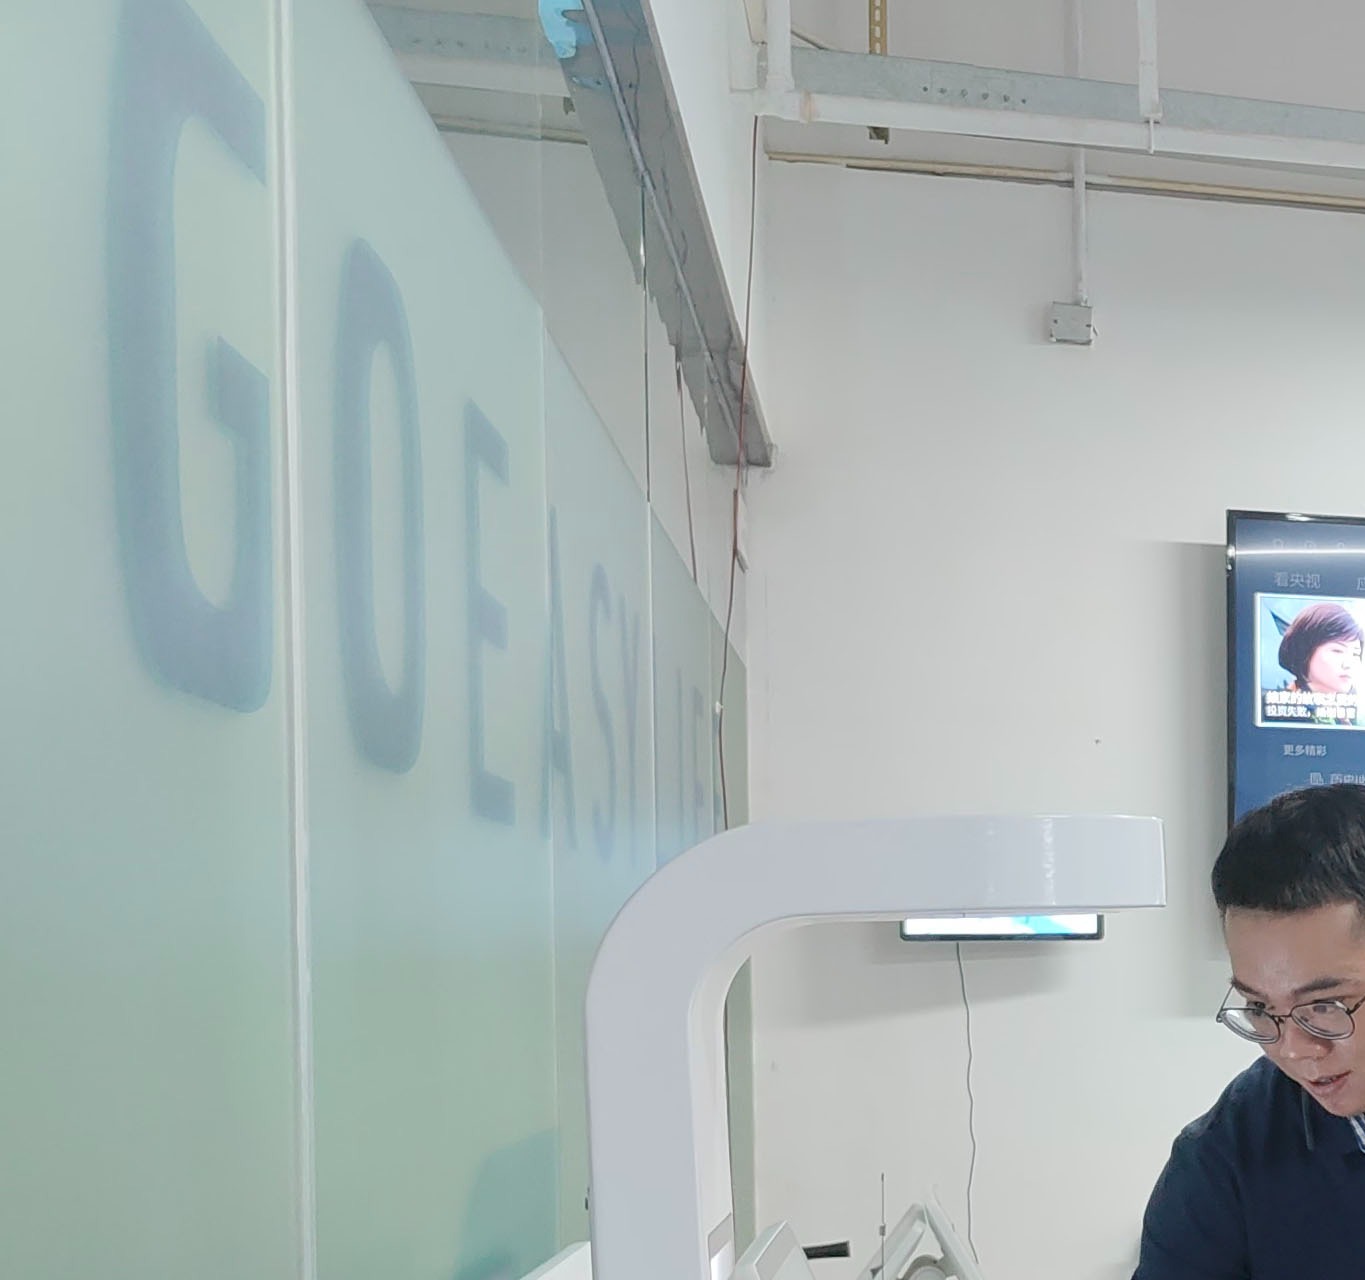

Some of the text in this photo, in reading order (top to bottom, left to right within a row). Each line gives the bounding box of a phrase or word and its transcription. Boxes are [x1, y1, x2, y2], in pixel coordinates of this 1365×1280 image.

[1274, 571, 1321, 589] 看央视
[1283, 744, 1327, 757] 更多精彩
